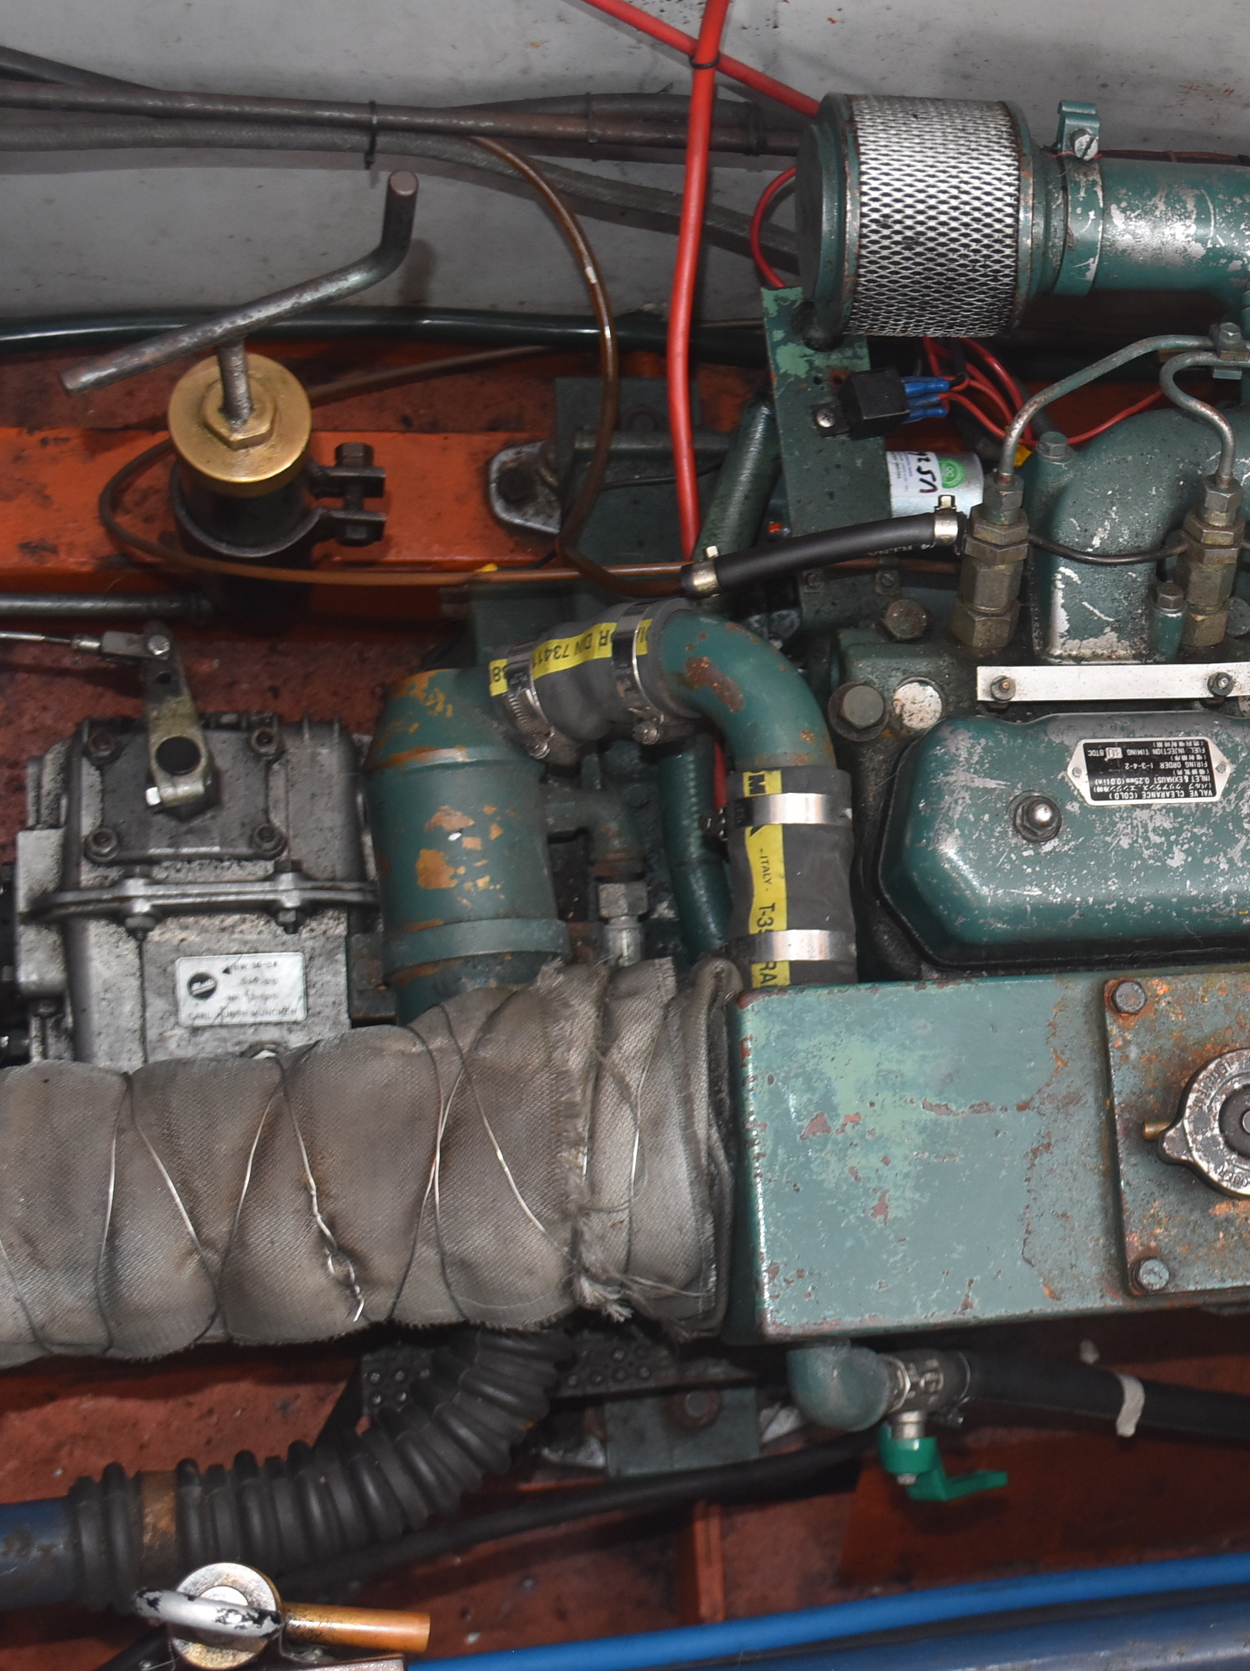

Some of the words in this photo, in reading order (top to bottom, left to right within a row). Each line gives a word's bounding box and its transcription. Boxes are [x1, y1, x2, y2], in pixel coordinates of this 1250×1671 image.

[1126, 748, 1149, 756] TIMING
[1152, 747, 1185, 755] INJECTION
[1124, 762, 1154, 770] 1-3-4-2
[1159, 761, 1182, 769] ORDER
[1184, 760, 1208, 768] FIRING
[1153, 776, 1183, 784] EXHAUST
[1141, 790, 1185, 799] CLEARANCE
[1189, 789, 1213, 797] VALVE
